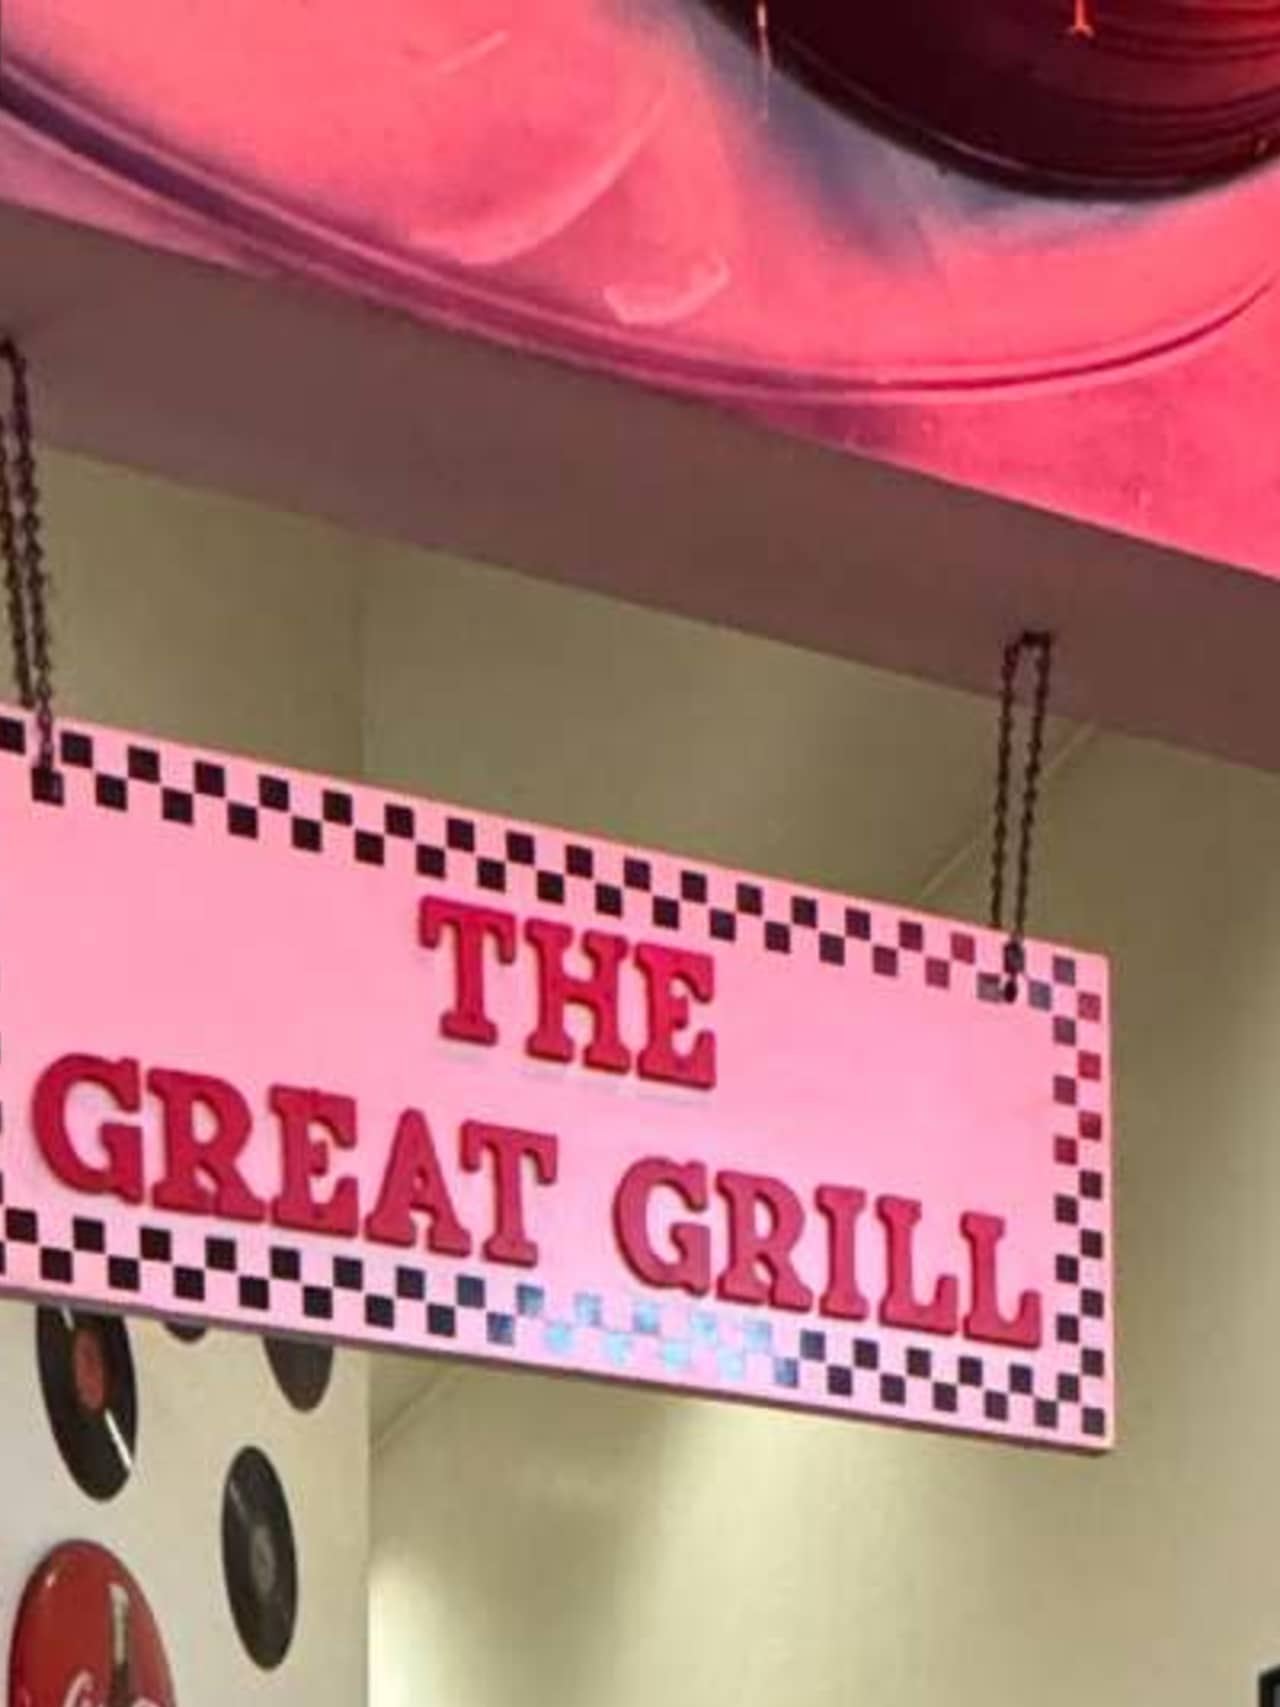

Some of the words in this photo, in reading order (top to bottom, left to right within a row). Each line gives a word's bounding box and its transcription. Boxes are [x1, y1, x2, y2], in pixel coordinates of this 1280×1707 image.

[419, 893, 717, 1091] THE
[32, 1050, 558, 1268] GREAT
[613, 1154, 1043, 1350] GRILL
